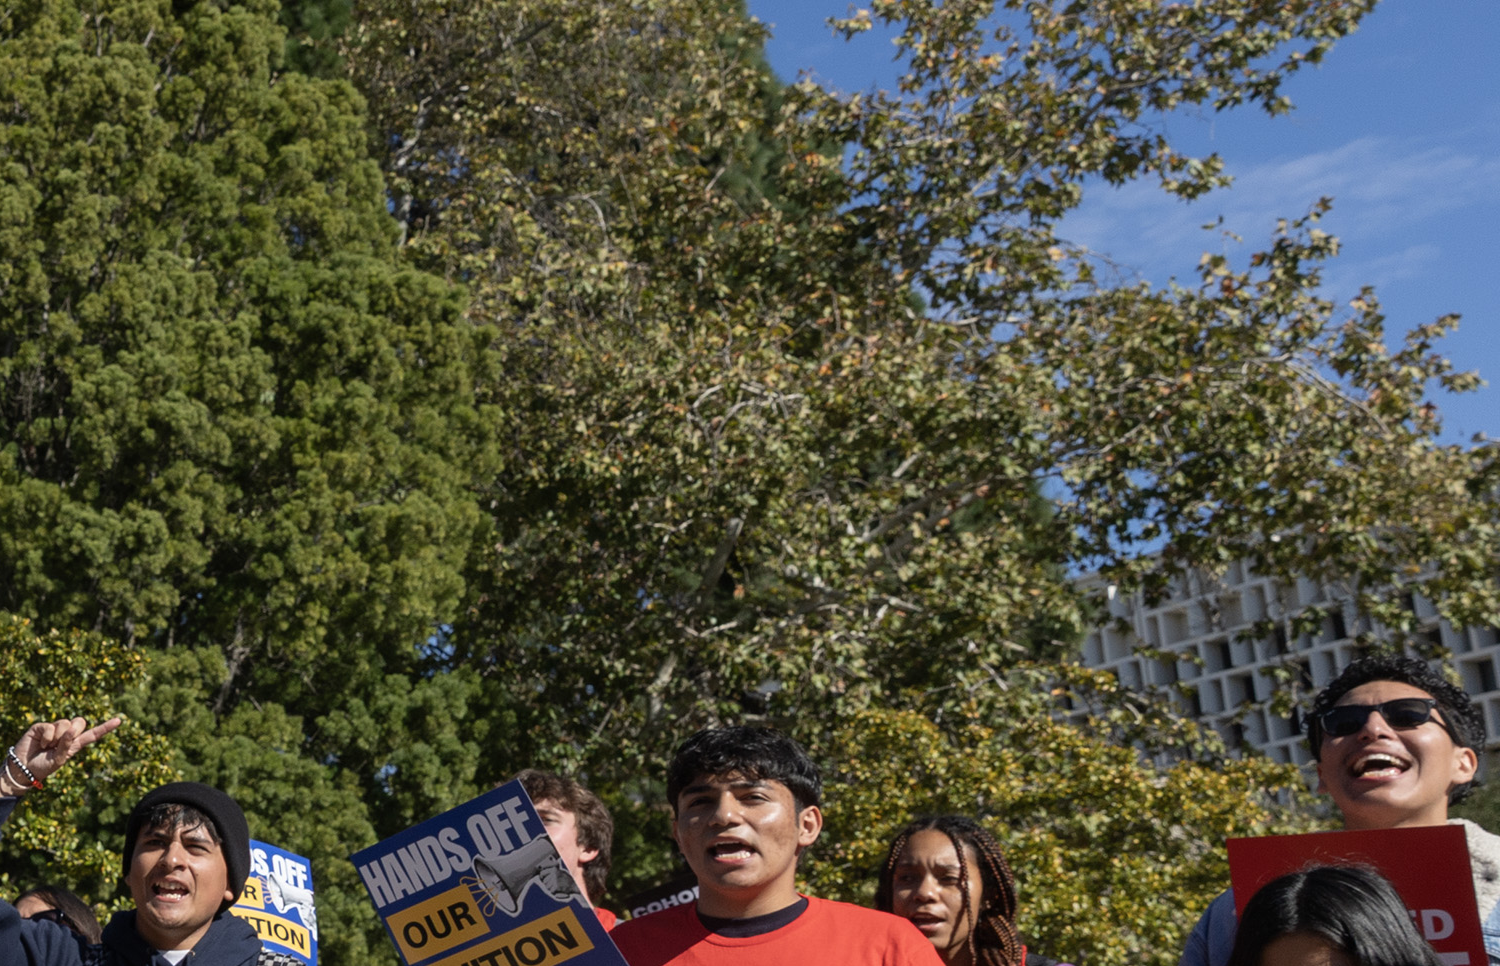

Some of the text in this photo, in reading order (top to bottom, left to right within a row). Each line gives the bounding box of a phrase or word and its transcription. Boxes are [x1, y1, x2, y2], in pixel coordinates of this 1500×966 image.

[271, 854, 308, 890] OFF
[358, 796, 532, 909] HANDS OFF
[248, 916, 305, 950] TION
[402, 901, 477, 949] OUR
